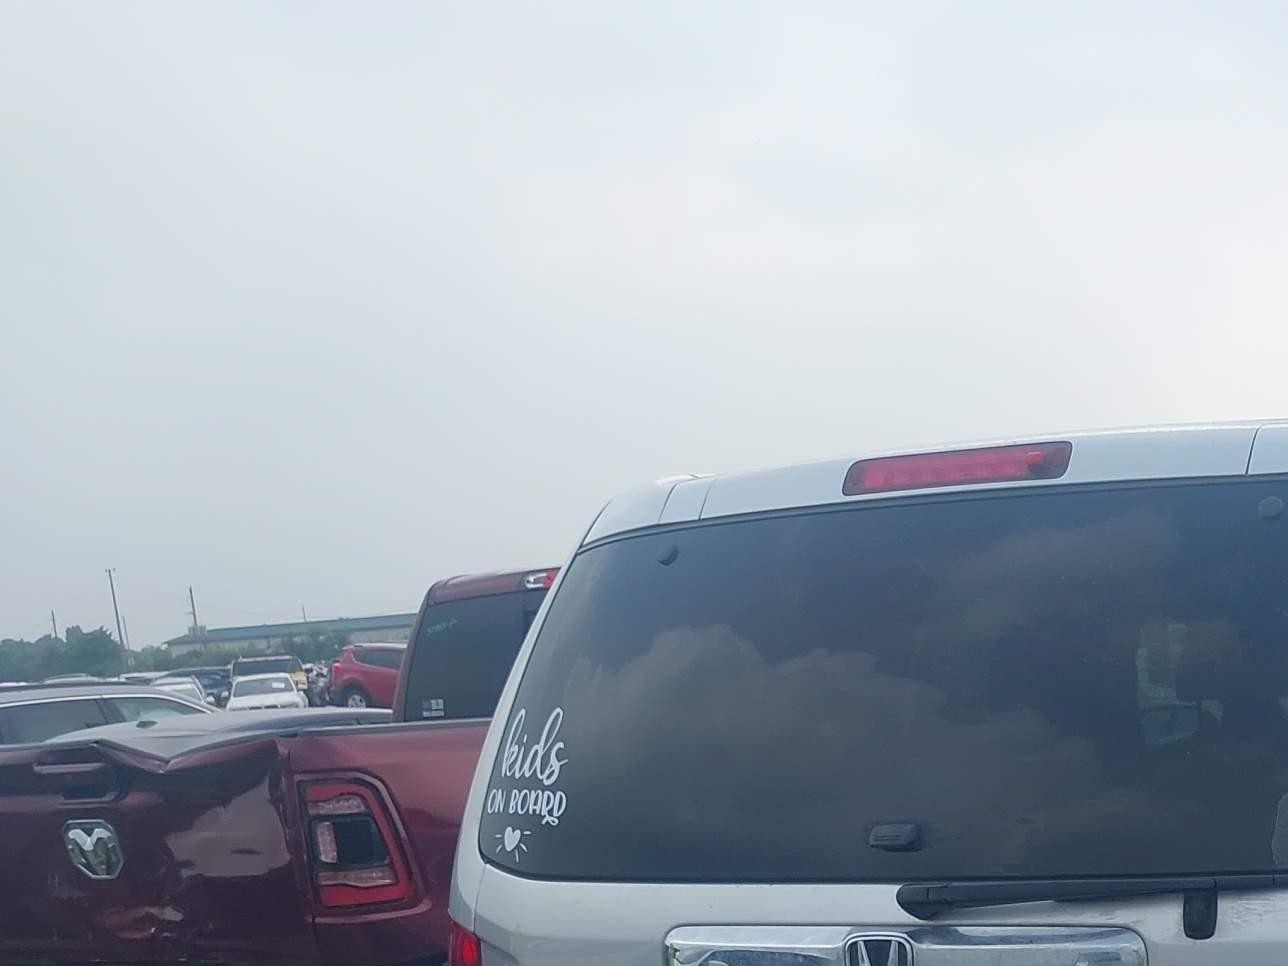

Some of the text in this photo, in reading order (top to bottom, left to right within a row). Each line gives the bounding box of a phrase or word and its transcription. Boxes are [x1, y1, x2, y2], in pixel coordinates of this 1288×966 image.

[501, 707, 569, 786] kids
[487, 788, 567, 826] ON BOARD
